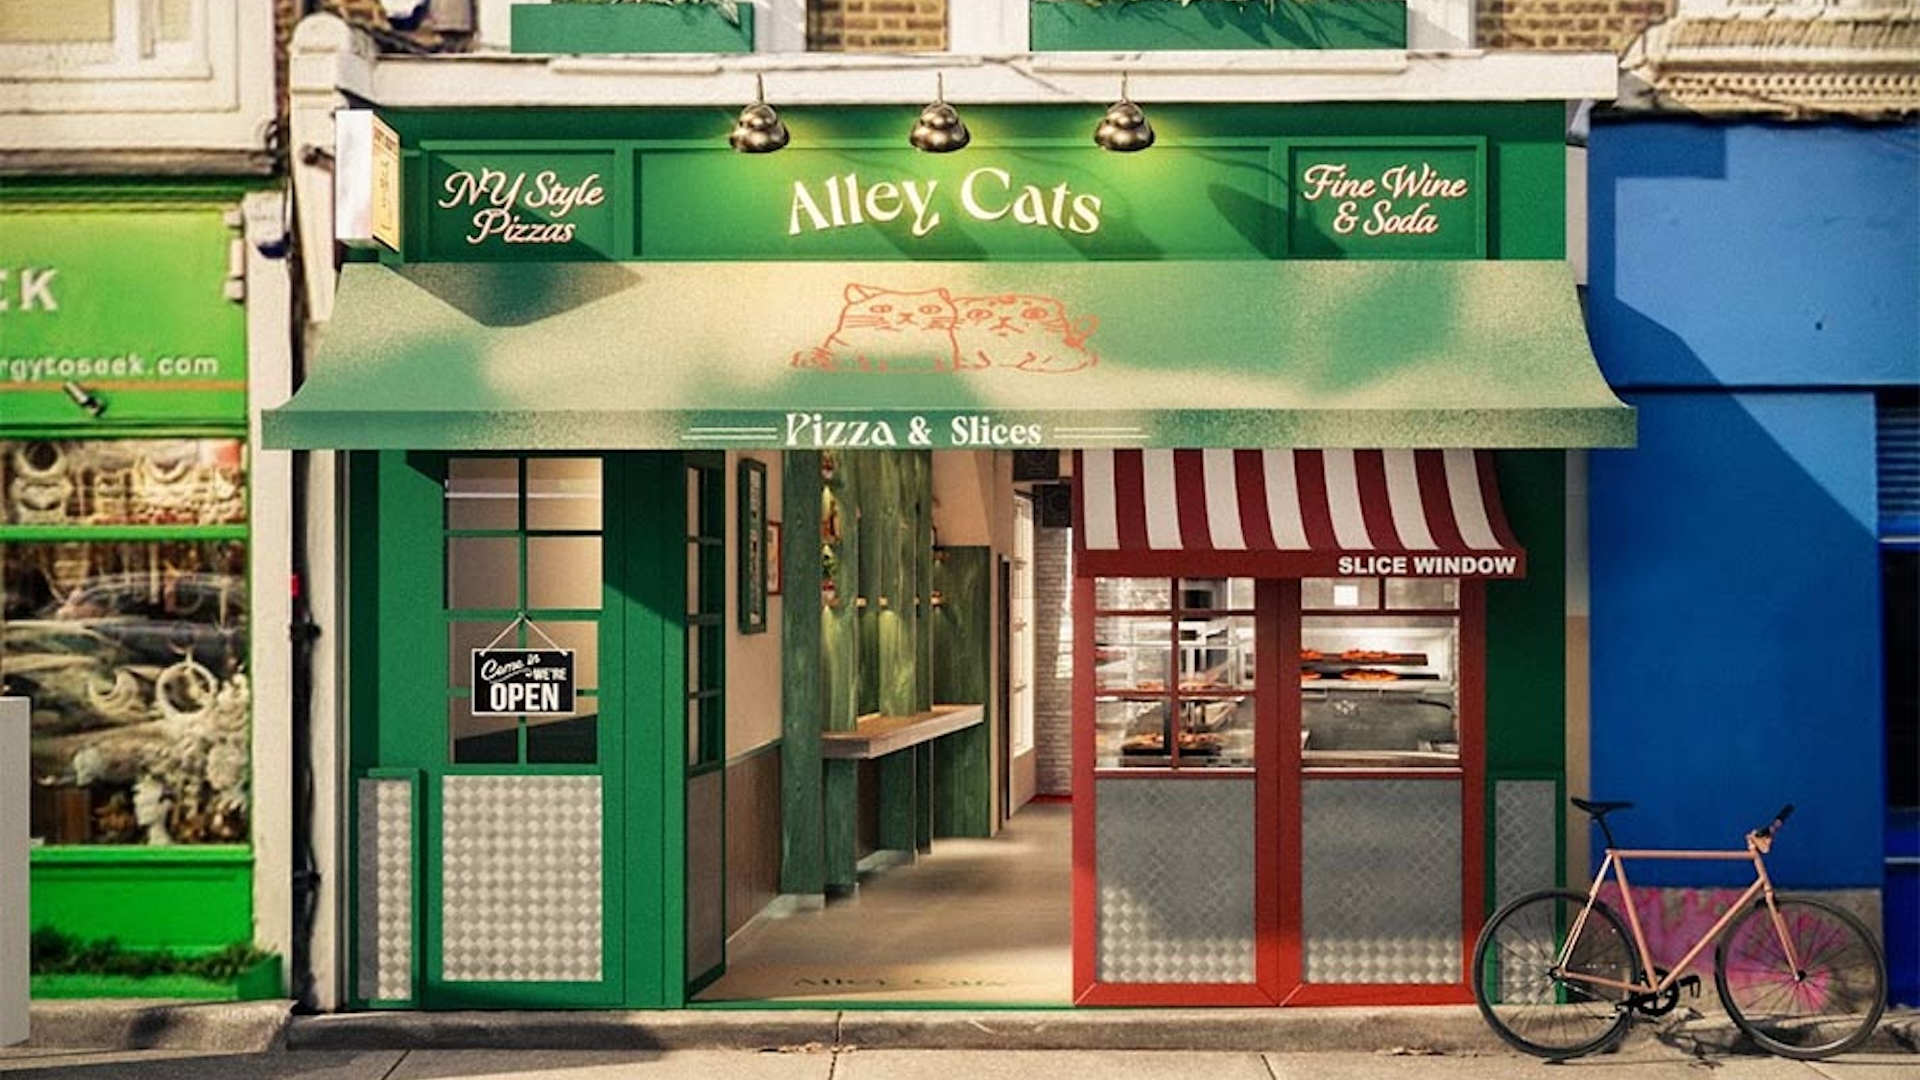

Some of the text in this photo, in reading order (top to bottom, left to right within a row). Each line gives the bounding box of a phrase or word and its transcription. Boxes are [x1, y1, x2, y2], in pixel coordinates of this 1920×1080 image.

[438, 167, 526, 212] NY
[524, 169, 604, 218] Style
[1303, 162, 1468, 200] Fine Wine
[788, 167, 1102, 238] Alley Cats
[1333, 199, 1439, 236] & Soda
[466, 208, 576, 244] Pizzas
[785, 413, 1042, 446] Pizza & Slices
[1338, 556, 1517, 574] SLICE WINDOW
[481, 659, 525, 681] Come
[532, 667, 568, 681] WE'RE
[490, 682, 560, 711] OPEN
